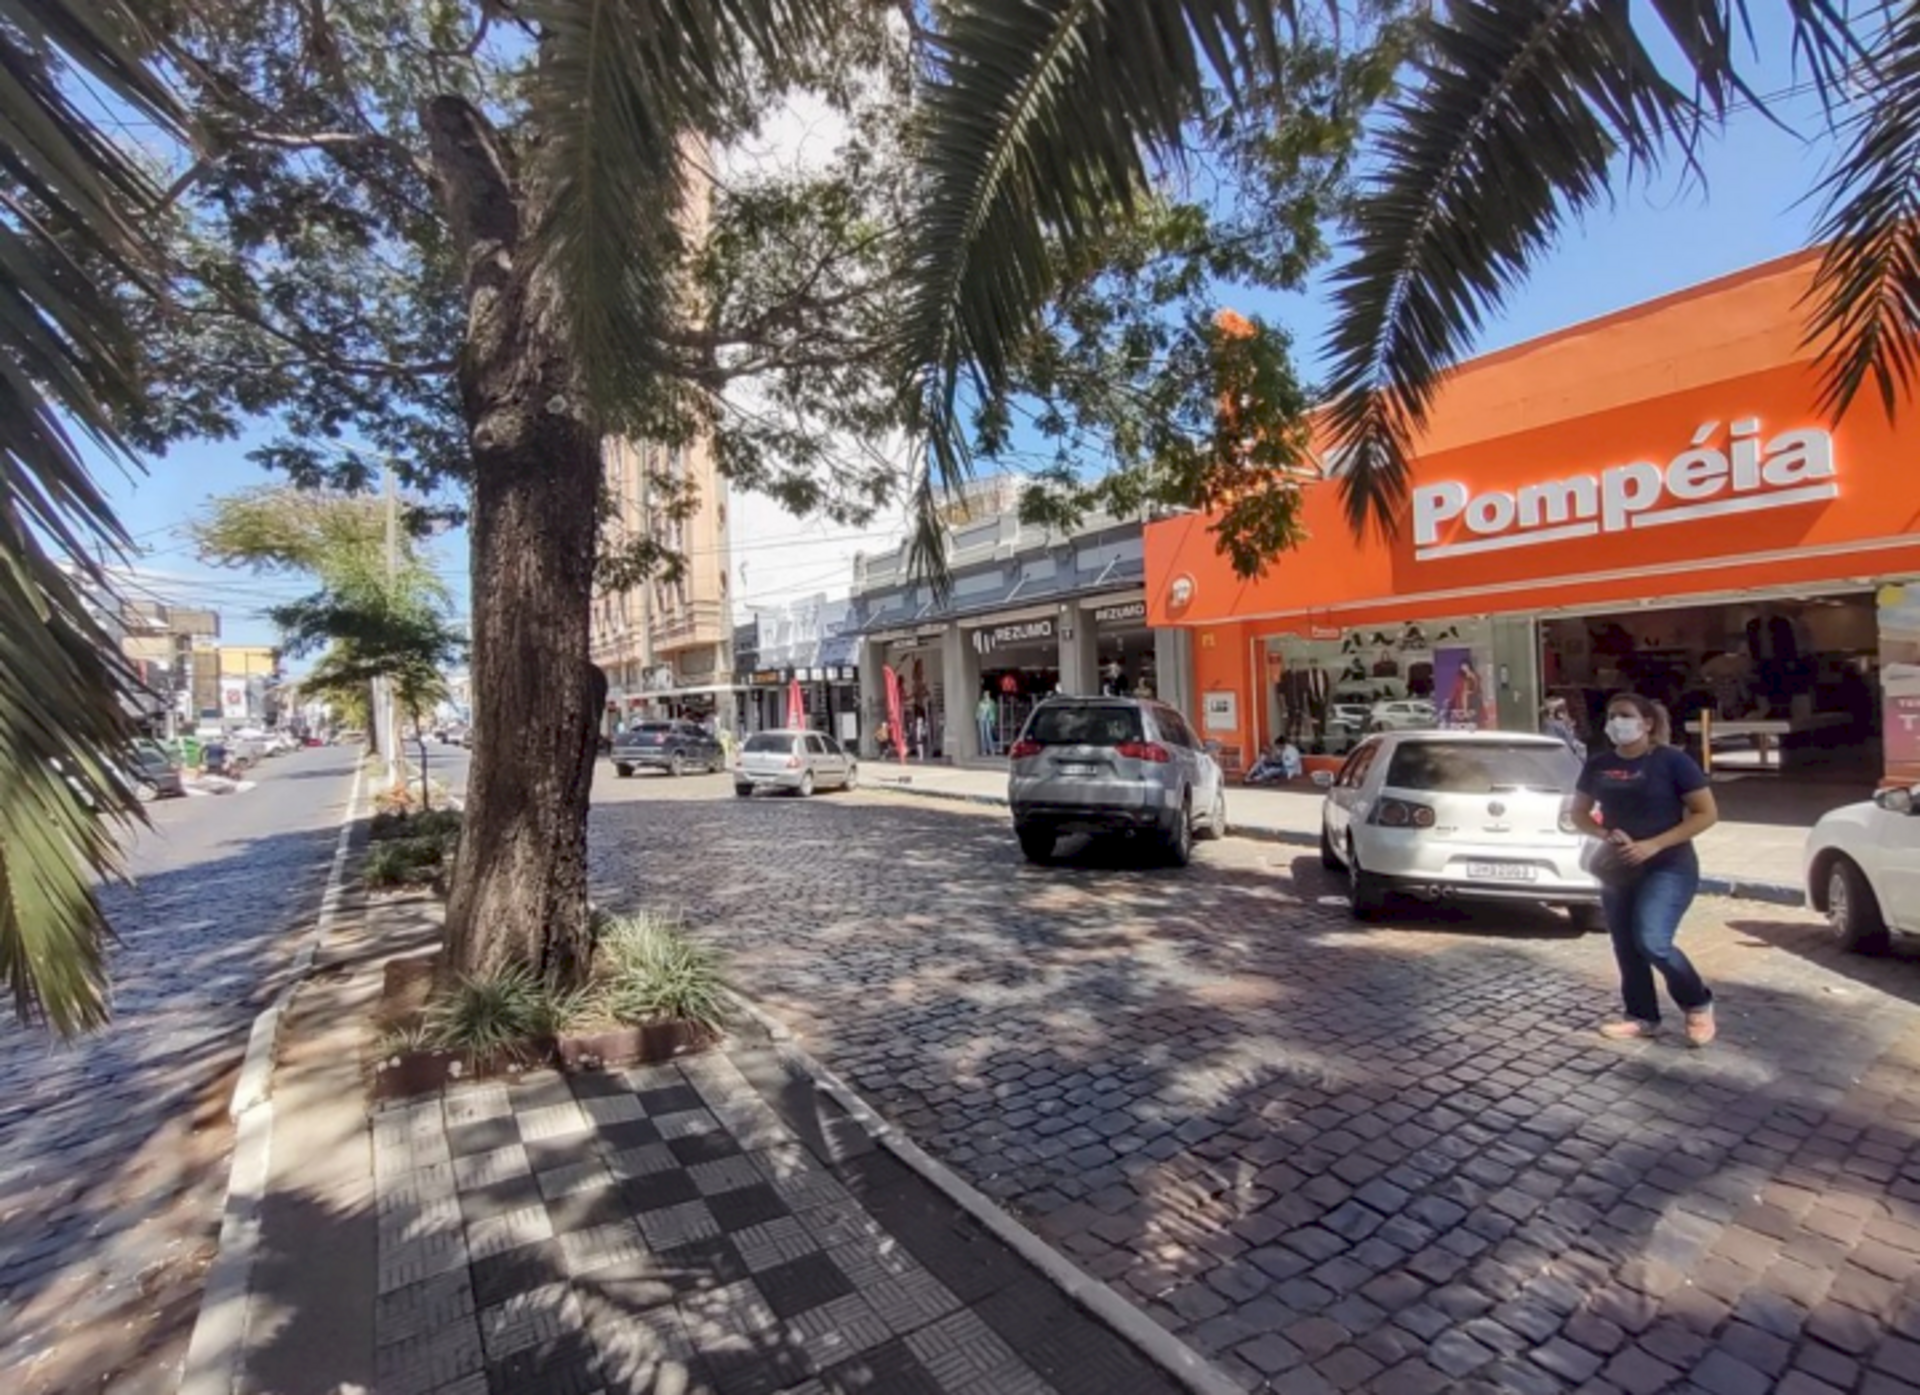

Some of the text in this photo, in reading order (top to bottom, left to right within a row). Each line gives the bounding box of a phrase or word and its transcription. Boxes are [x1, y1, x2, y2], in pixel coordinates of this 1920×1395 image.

[1412, 416, 1838, 546] Pompéia
[1094, 602, 1145, 622] REZUMO
[993, 620, 1052, 642] REZUMO
